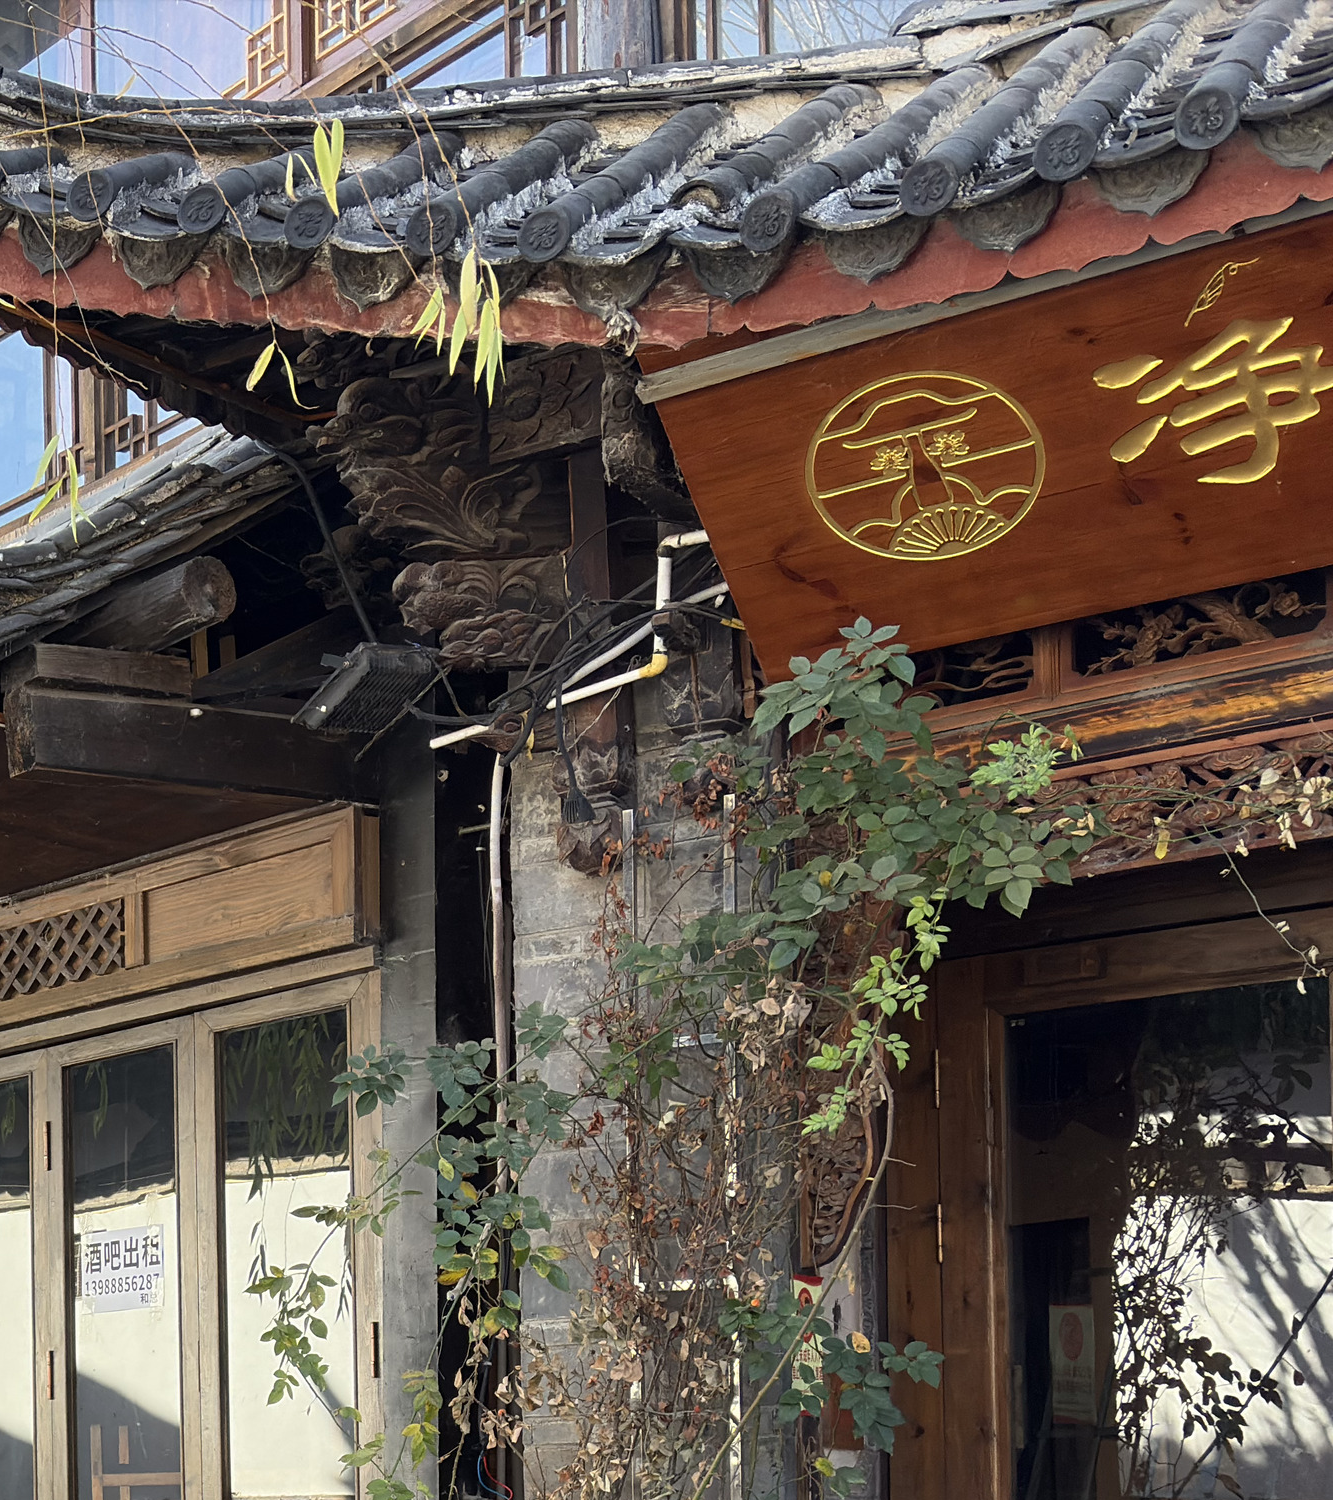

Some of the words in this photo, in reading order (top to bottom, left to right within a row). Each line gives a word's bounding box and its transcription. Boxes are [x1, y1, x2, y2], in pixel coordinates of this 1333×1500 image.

[1092, 315, 1333, 485] 净
[85, 1234, 161, 1275] 酒吧出租
[85, 1273, 160, 1297] 13988856287
